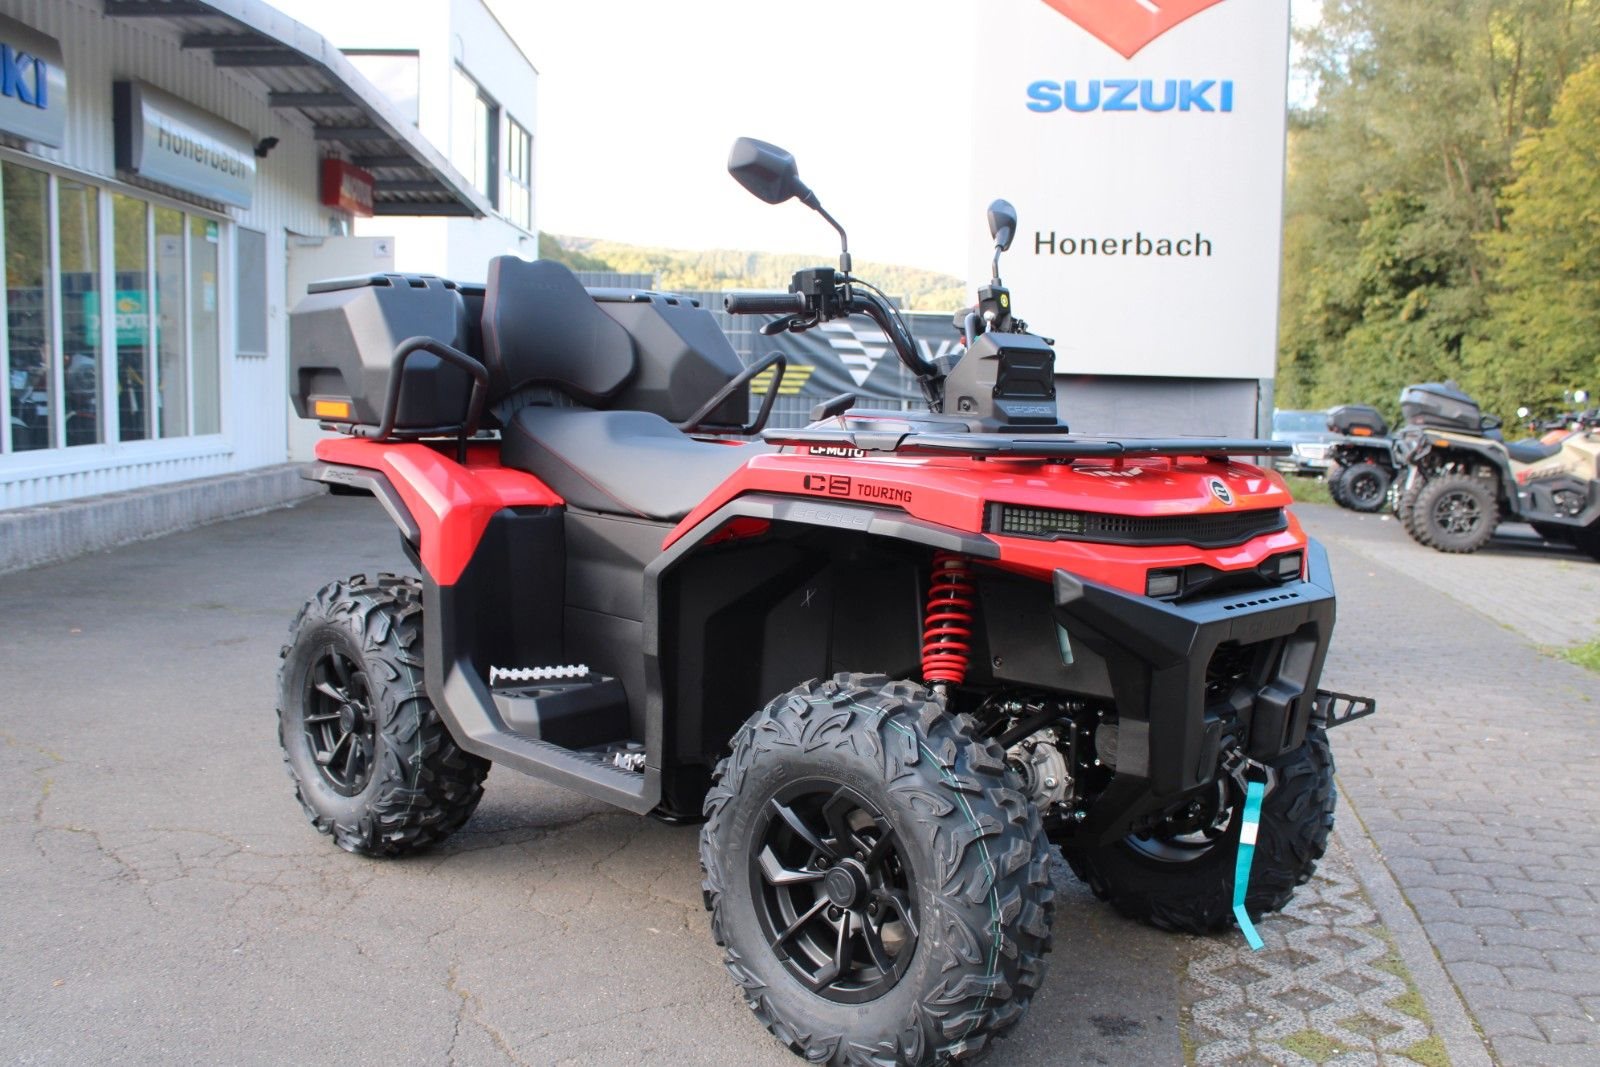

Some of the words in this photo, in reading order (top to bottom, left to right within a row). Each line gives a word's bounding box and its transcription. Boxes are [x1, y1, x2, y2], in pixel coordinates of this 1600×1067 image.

[0, 43, 48, 110] KI
[1025, 79, 1234, 113] SUZUKI
[1034, 231, 1213, 257] Honerbach
[857, 483, 913, 503] TOURING
